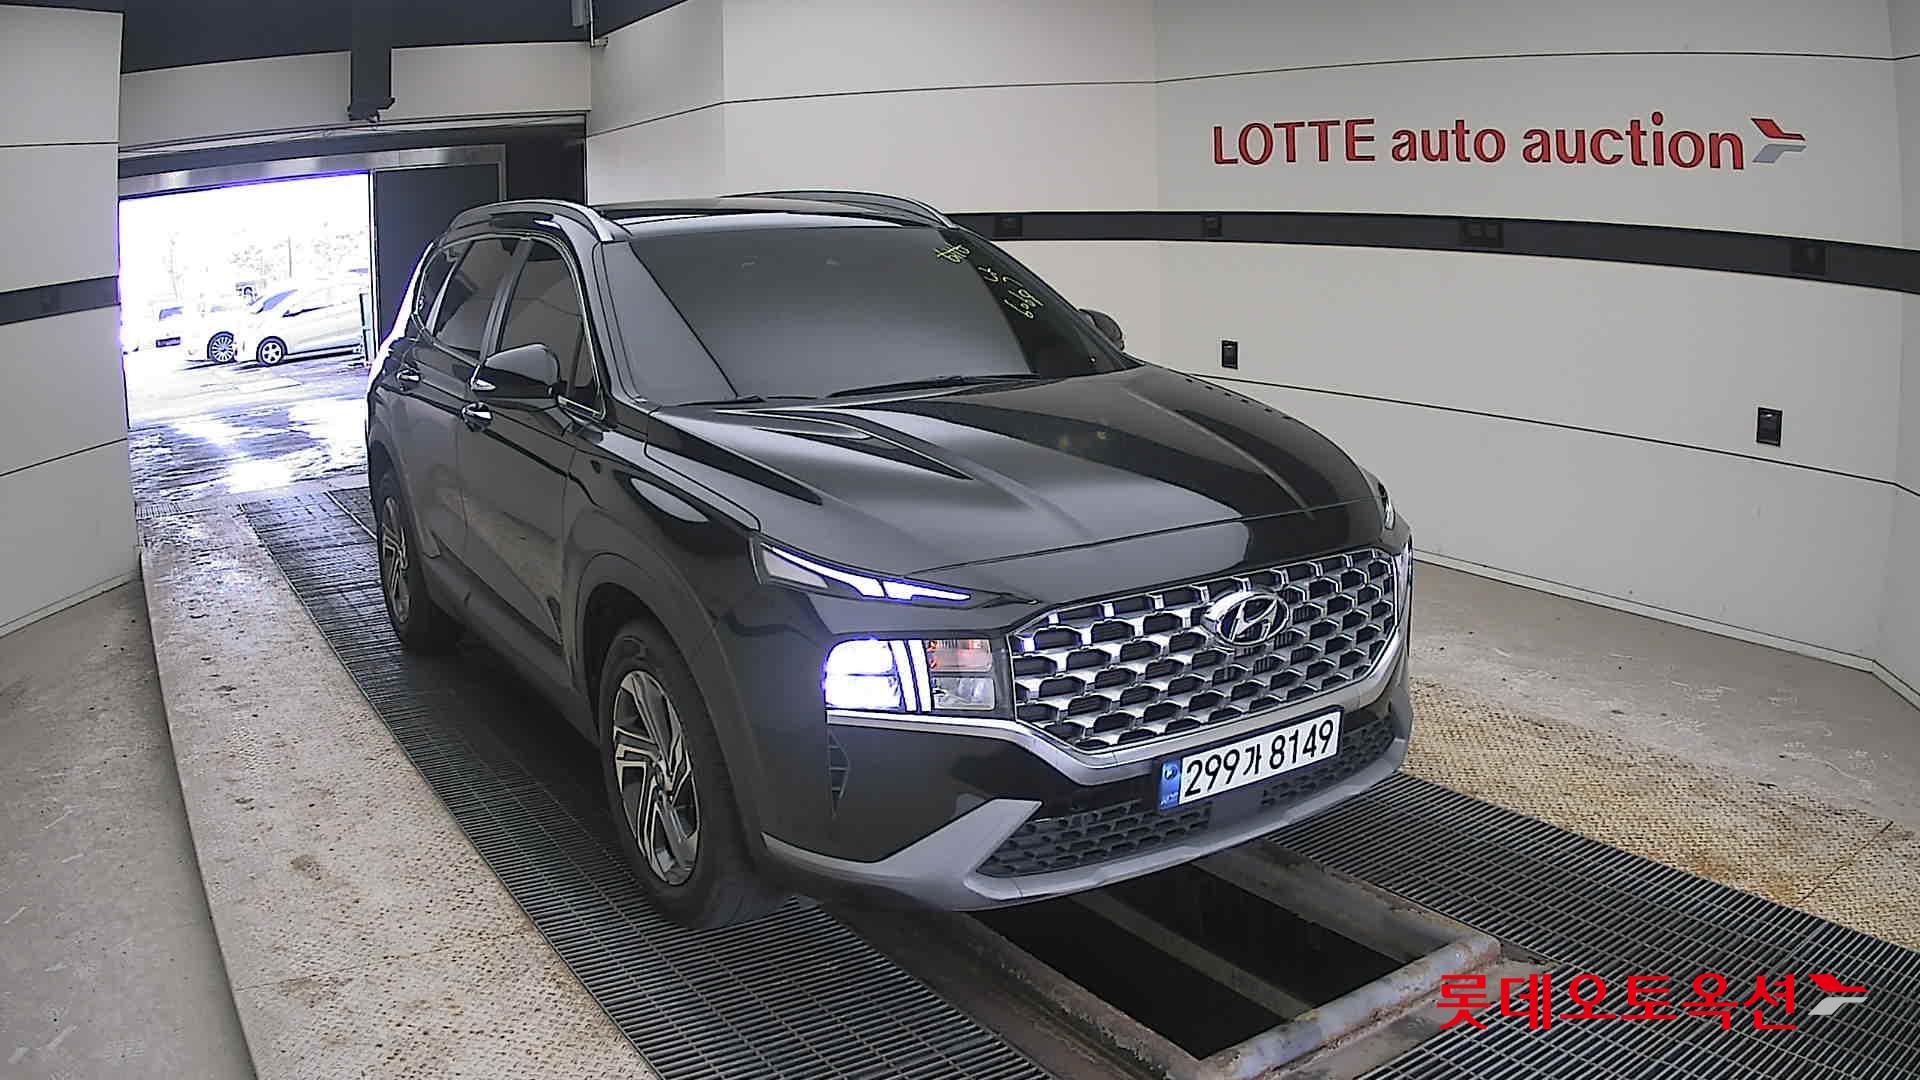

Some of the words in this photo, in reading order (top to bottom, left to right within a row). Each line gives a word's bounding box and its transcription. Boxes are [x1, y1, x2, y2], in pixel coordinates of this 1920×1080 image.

[1213, 119, 1375, 165] LOTTE
[1391, 119, 1506, 163] auto
[1522, 111, 1745, 170] auction
[1184, 743, 1263, 798] 299가
[1269, 718, 1334, 770] 8149
